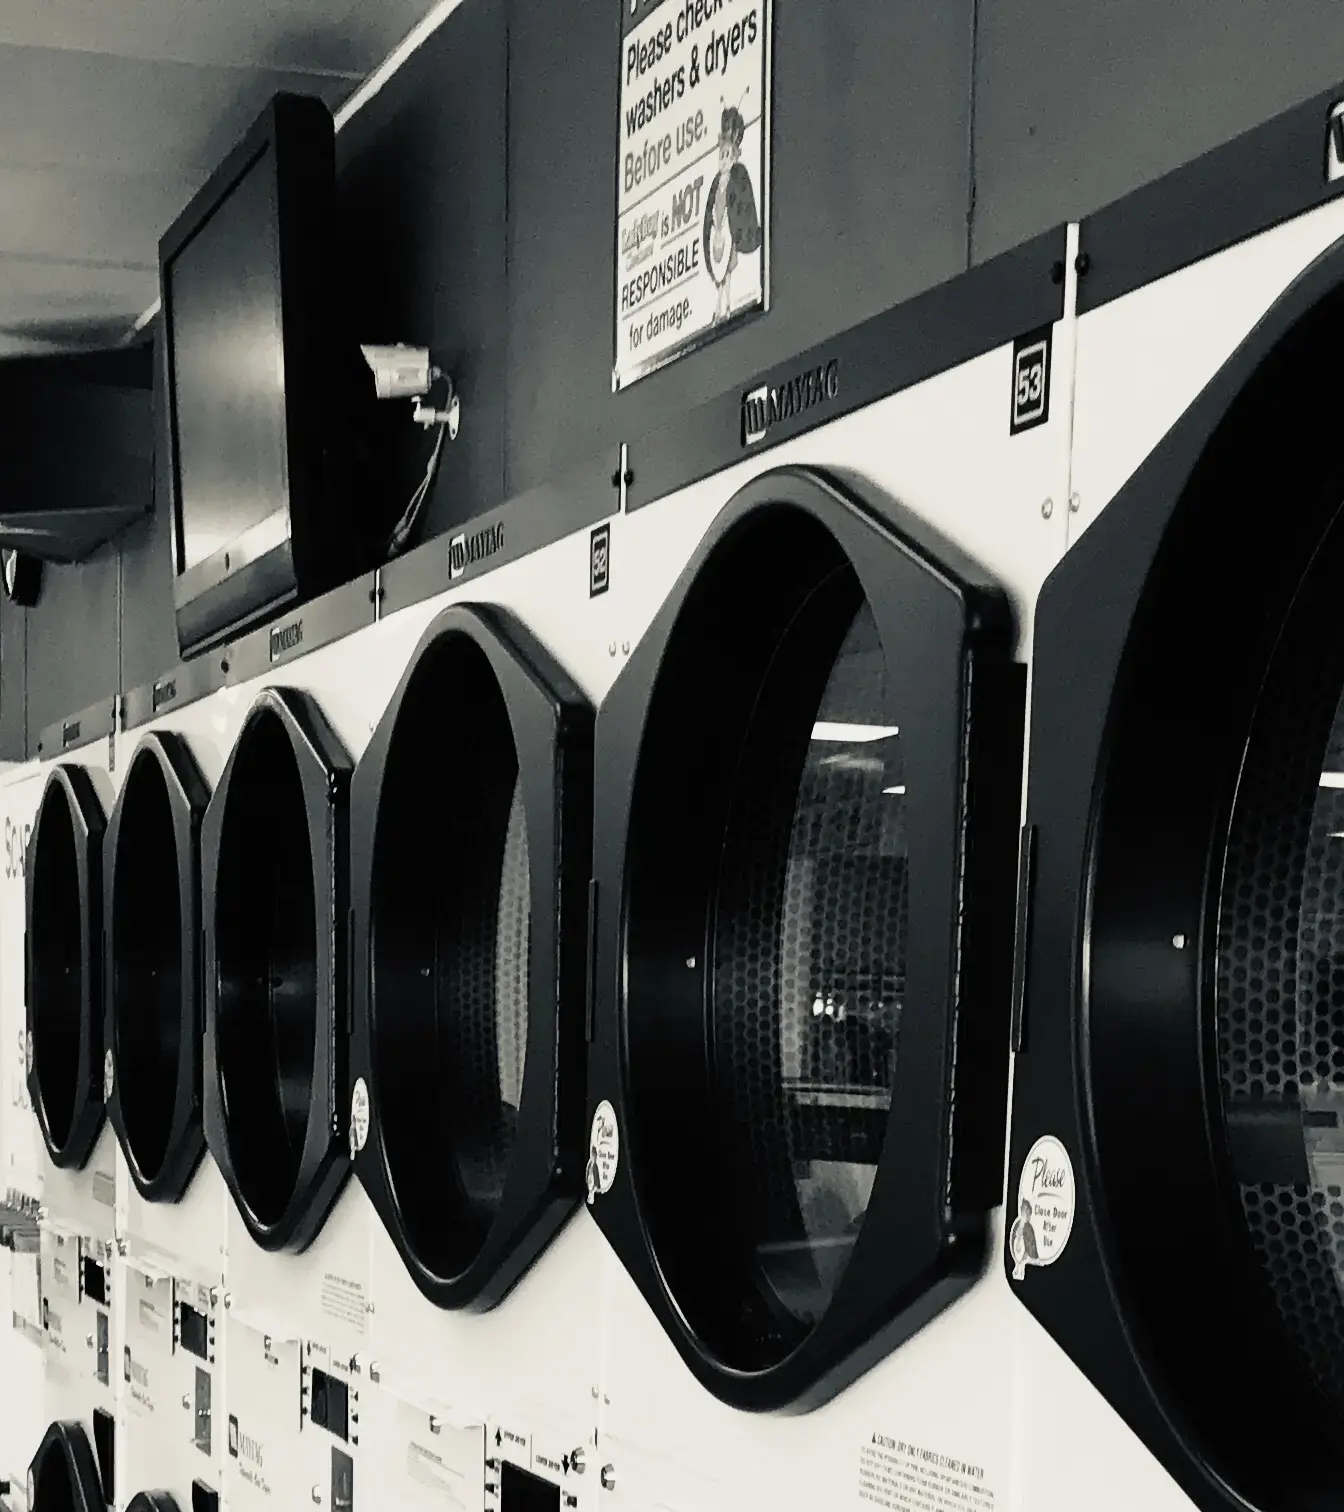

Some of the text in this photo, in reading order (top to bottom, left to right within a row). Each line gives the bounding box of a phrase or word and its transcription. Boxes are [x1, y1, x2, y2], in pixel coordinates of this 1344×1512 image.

[626, 8, 757, 138] washers & dryers
[627, 21, 672, 86] Please
[624, 108, 707, 194] Before use.
[661, 175, 704, 239] is NOT
[621, 237, 700, 312] RESPONSIBLE
[629, 296, 693, 352] for damage.
[768, 359, 839, 426] MAYTAG
[1017, 362, 1043, 406] 53
[1031, 1156, 1066, 1192] Please
